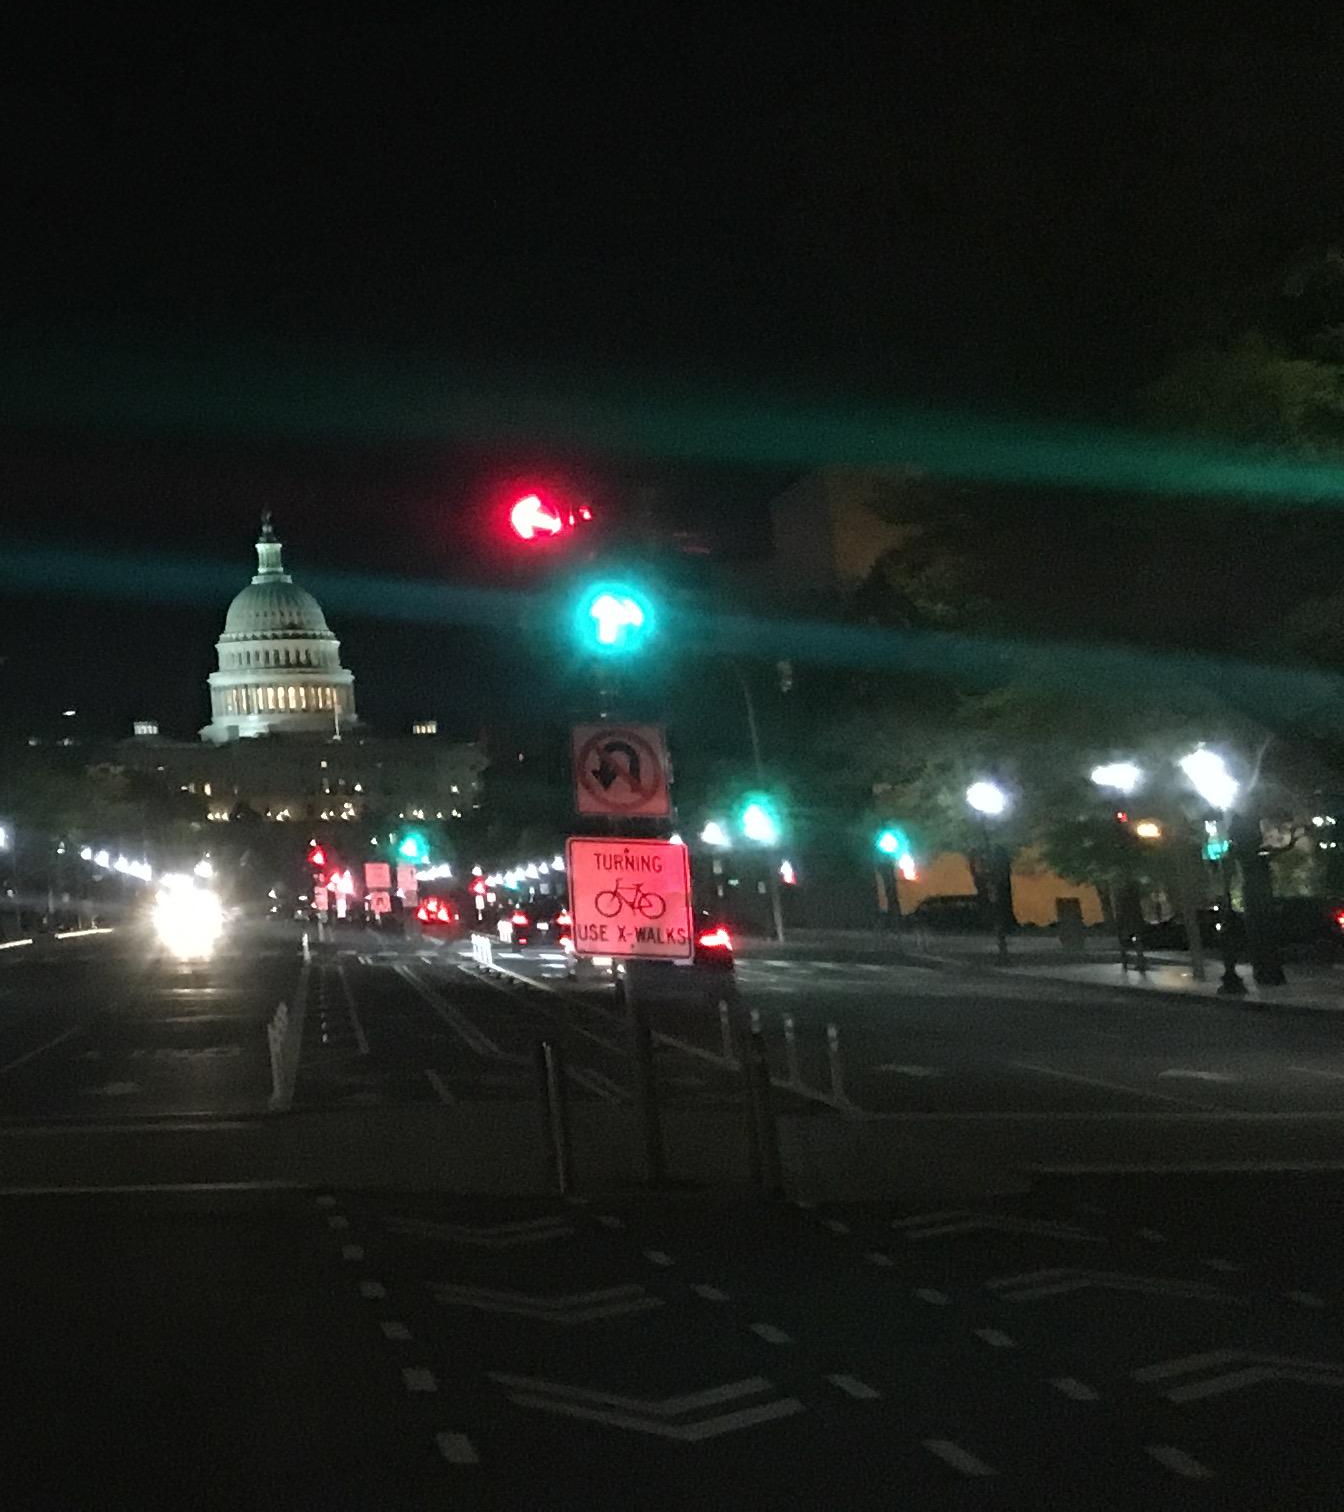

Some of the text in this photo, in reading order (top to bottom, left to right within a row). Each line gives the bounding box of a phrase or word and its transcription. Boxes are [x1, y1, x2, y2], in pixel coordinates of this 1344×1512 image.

[594, 852, 663, 873] TURNING
[577, 923, 687, 945] USE X-WALKS
